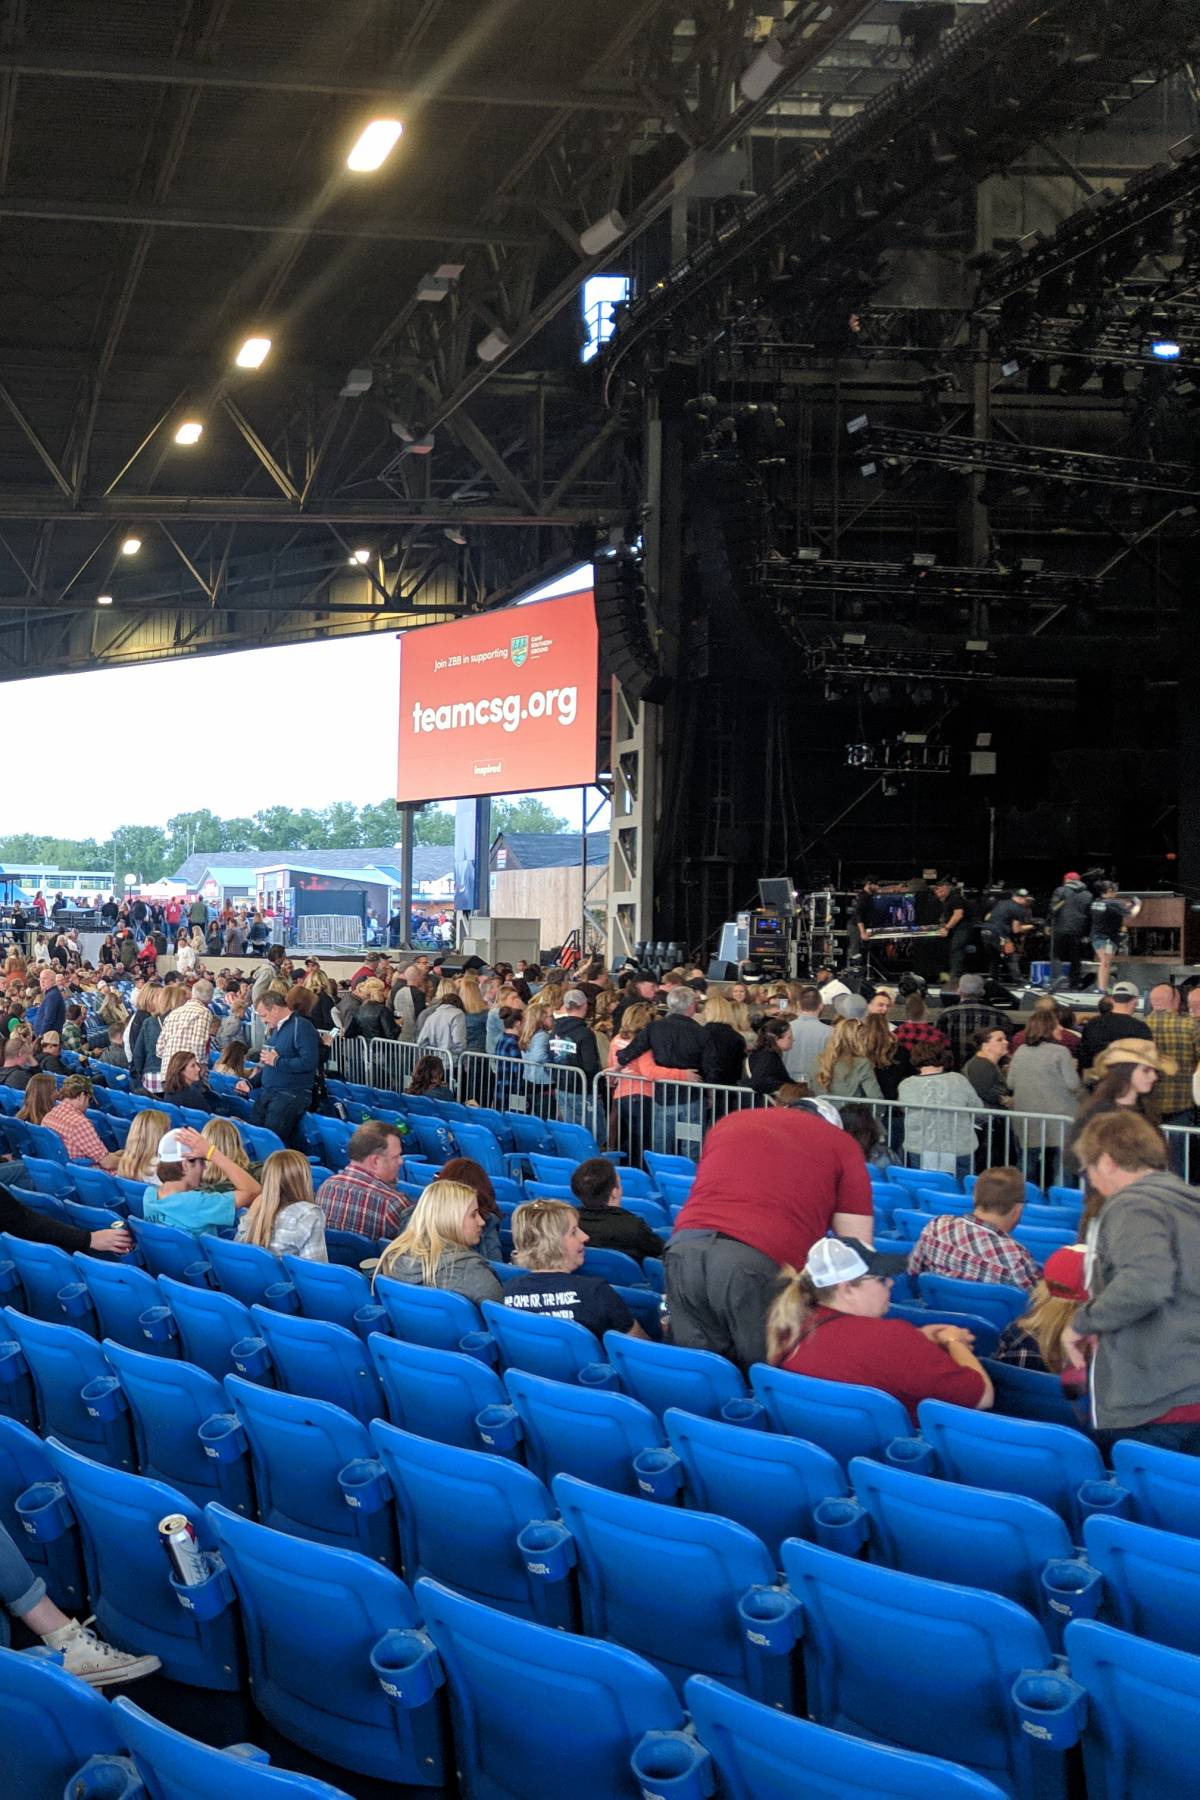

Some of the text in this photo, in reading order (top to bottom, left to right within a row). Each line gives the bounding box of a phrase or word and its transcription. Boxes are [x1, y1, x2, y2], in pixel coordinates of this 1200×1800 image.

[434, 648, 509, 672] Join ZBB in supporting
[413, 687, 577, 733] teamcsg.org
[473, 762, 502, 776] inspired
